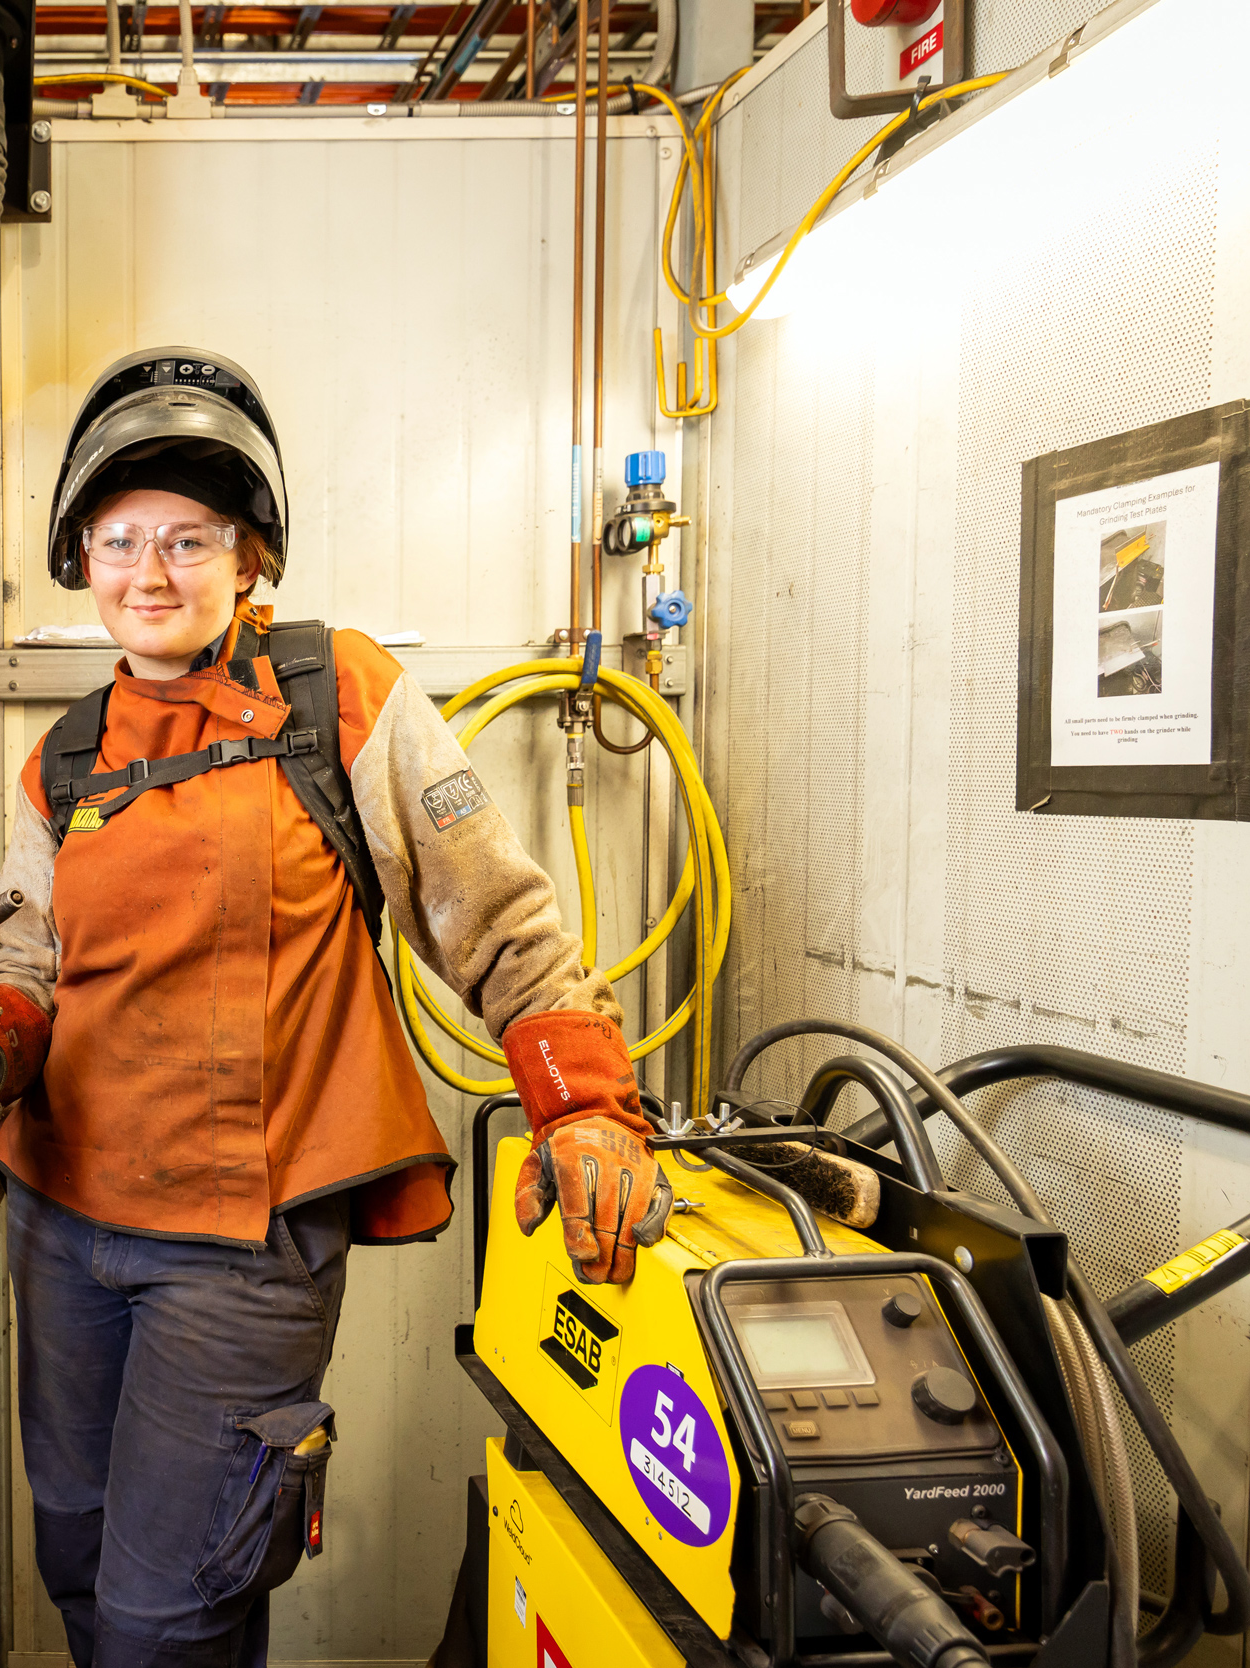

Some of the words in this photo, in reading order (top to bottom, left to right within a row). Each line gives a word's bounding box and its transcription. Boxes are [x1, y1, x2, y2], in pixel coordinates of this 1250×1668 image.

[911, 32, 937, 65] FIRE
[1076, 504, 1112, 518] Mandatory
[1113, 496, 1147, 510] Clamping
[1147, 488, 1183, 503] Examples
[1185, 485, 1196, 494] for
[1099, 512, 1129, 525] Grinding
[1130, 510, 1144, 519] Test
[1145, 504, 1168, 516] Plates
[1137, 714, 1158, 722] clamped
[1174, 712, 1199, 720] grinding.
[1156, 727, 1175, 735] grinder
[538, 1039, 571, 1101] ELLIOTTS
[553, 1304, 602, 1374] ESAB
[650, 1389, 696, 1473] 54
[644, 1454, 692, 1518] 314512
[904, 1485, 970, 1500] YardFeed
[972, 1483, 1006, 1497] 2000
